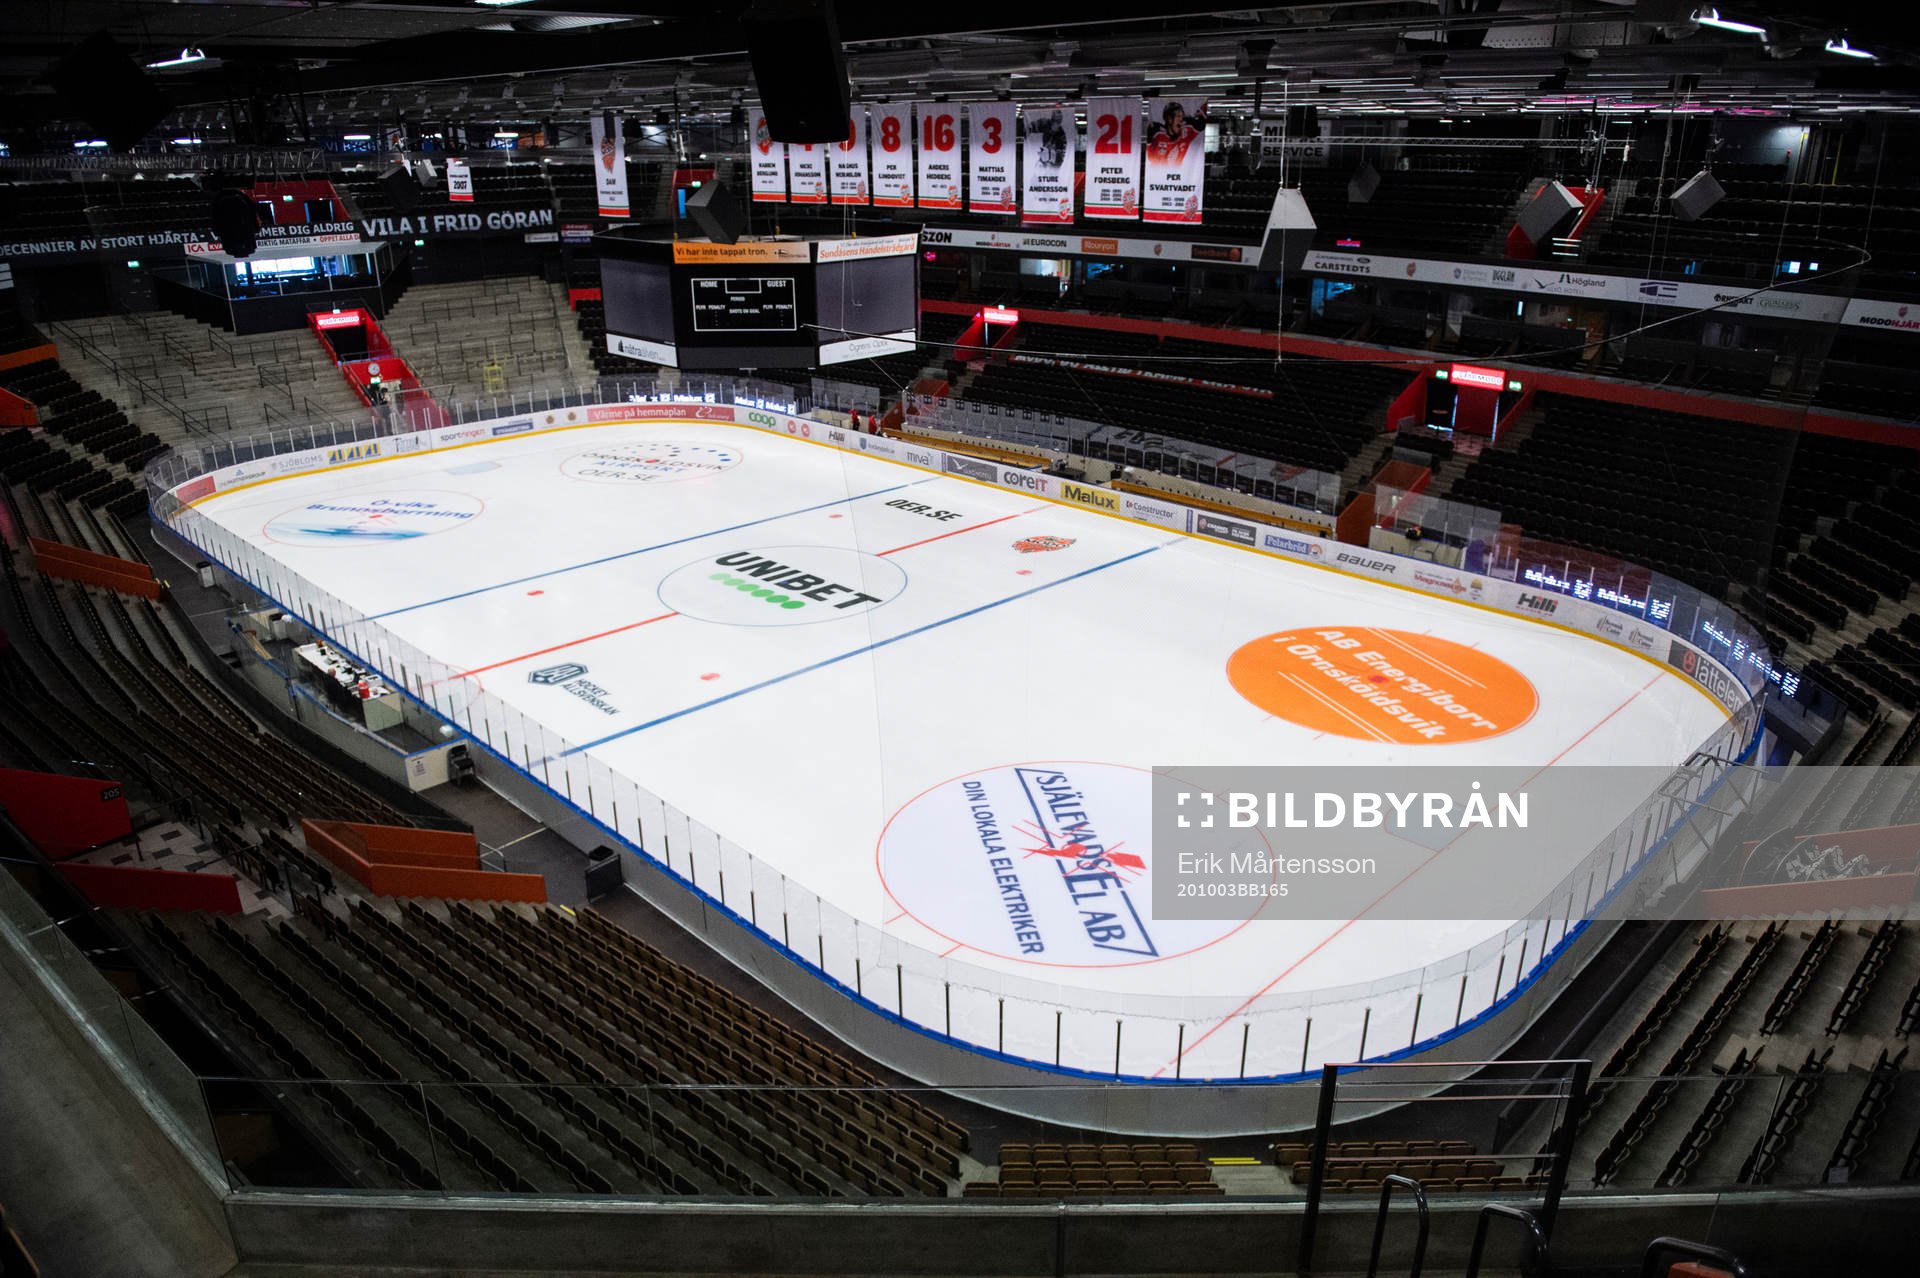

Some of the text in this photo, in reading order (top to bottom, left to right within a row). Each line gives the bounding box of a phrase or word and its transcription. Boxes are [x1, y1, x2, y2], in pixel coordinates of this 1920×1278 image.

[881, 116, 901, 152] 8
[923, 114, 955, 152] 16
[982, 117, 1002, 154] 3
[1094, 114, 1133, 154] 21
[1263, 146, 1324, 157] SERVICE
[453, 180, 467, 190] 2007
[1094, 176, 1130, 184] FORSBERG
[1166, 173, 1181, 181] PER
[1149, 184, 1196, 192] SVARTVADET
[289, 225, 311, 235] DIG
[313, 222, 354, 234] ALDRIG
[362, 209, 553, 237] VILA I FRID GÖRAN
[0, 241, 77, 256] DECENNIER
[80, 239, 97, 250] AV
[101, 235, 145, 249] STORT
[148, 231, 199, 245] HJÄRTA
[187, 243, 204, 253] ICA
[1031, 239, 1067, 247] EUROCON
[719, 247, 746, 257] tappat
[1314, 262, 1370, 273] CARSTEDTS
[766, 280, 787, 288] GUEST
[593, 407, 686, 420] Värme på hemmaplan
[749, 411, 777, 427] coop
[440, 428, 486, 442] sportringen
[594, 460, 689, 473] AIRPORT
[906, 451, 930, 466] miva
[578, 469, 661, 482] OER.SE
[1064, 485, 1115, 509] Malux
[885, 499, 964, 523] OER.SE
[1133, 502, 1173, 519] Constructor
[1266, 535, 1308, 554] Polarbröd
[1336, 552, 1397, 574] BAUER
[714, 551, 884, 610] UNIBET
[1517, 592, 1559, 613] Hilli
[575, 678, 611, 696] HOCKEY
[1314, 630, 1498, 731] AB Energiborr
[561, 682, 621, 716] ALLSVENSKAN
[1286, 644, 1447, 740] Örnsköldsvik
[961, 780, 1046, 955] DIN LOKALA ELEKTRIKER
[1036, 773, 1112, 874] SJÄLEVADS
[1078, 908, 1126, 948] AB
